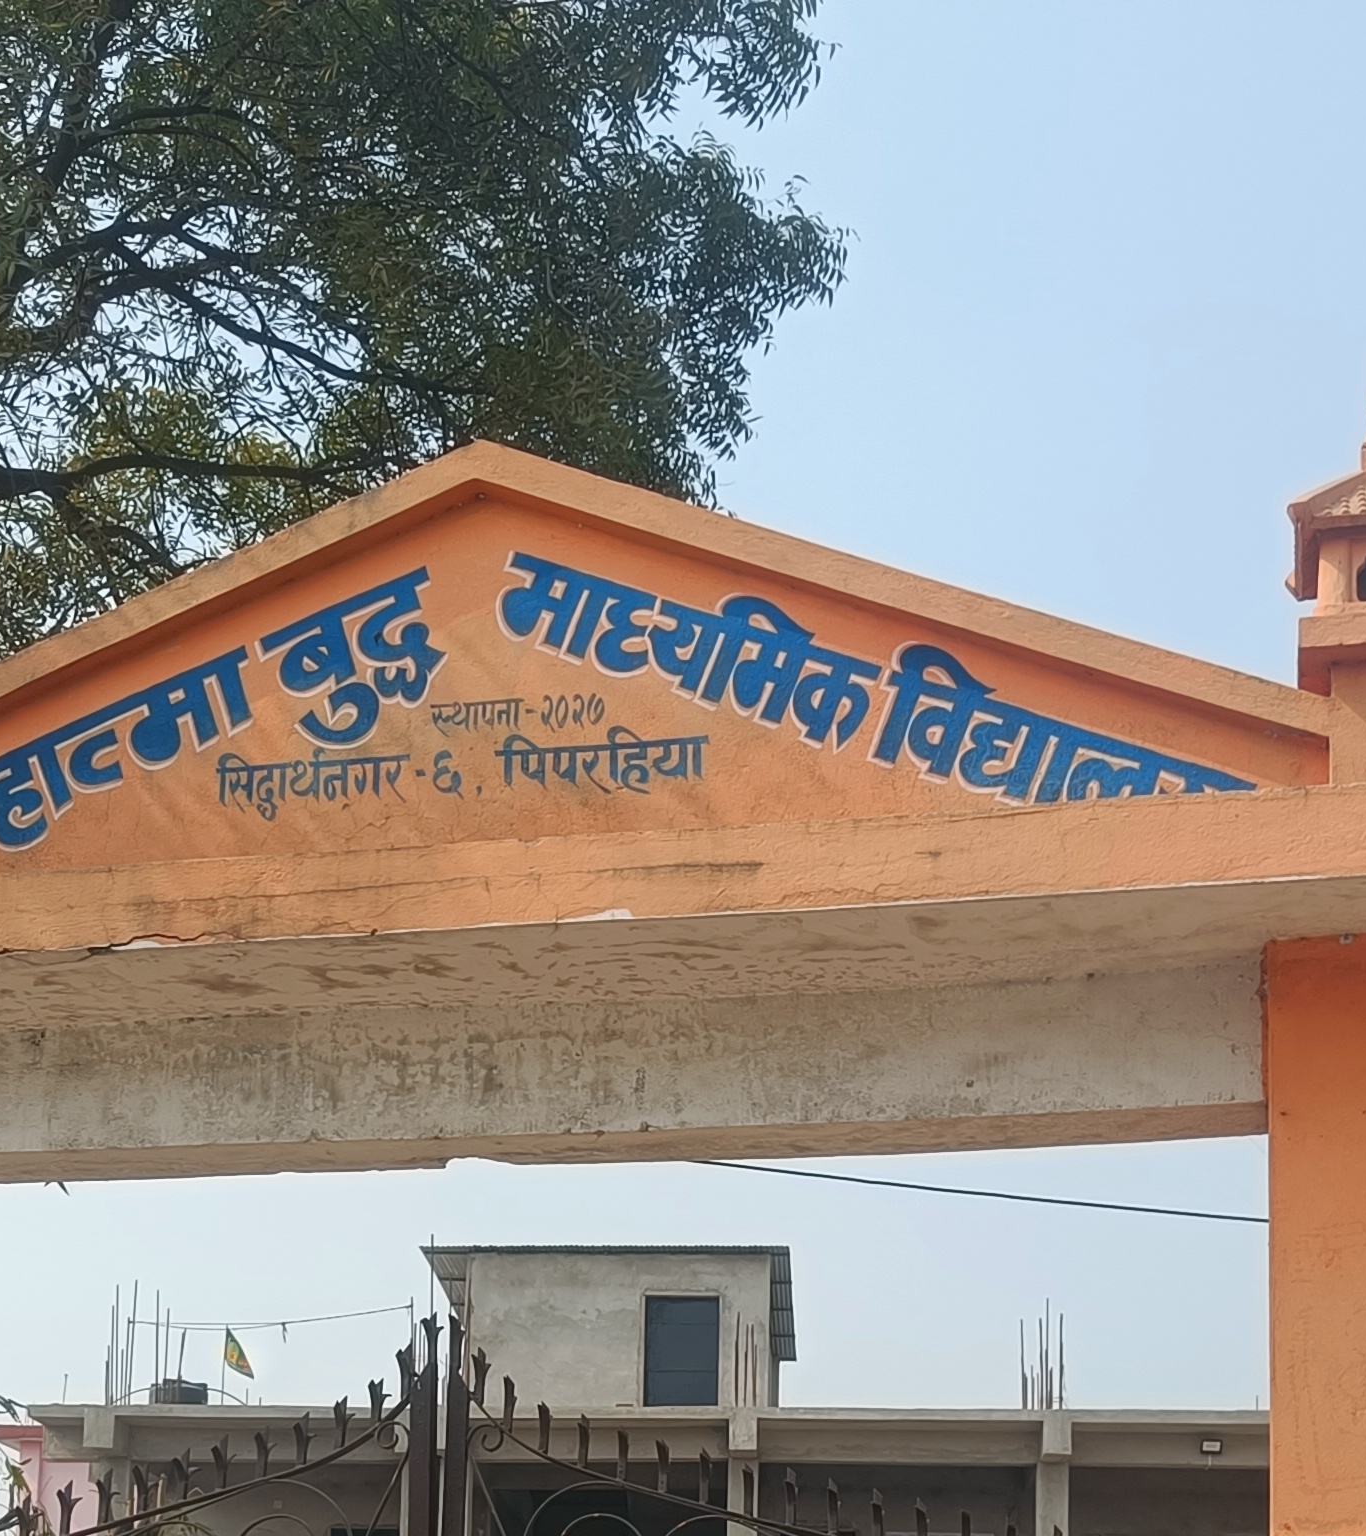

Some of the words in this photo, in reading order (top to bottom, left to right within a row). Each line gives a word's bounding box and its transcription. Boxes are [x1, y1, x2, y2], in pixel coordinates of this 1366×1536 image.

[254, 565, 448, 749] बुद्ध
[496, 551, 883, 753] माध्यमिक
[866, 641, 1258, 806] विद्याल
[494, 725, 711, 794] पिपरहिया
